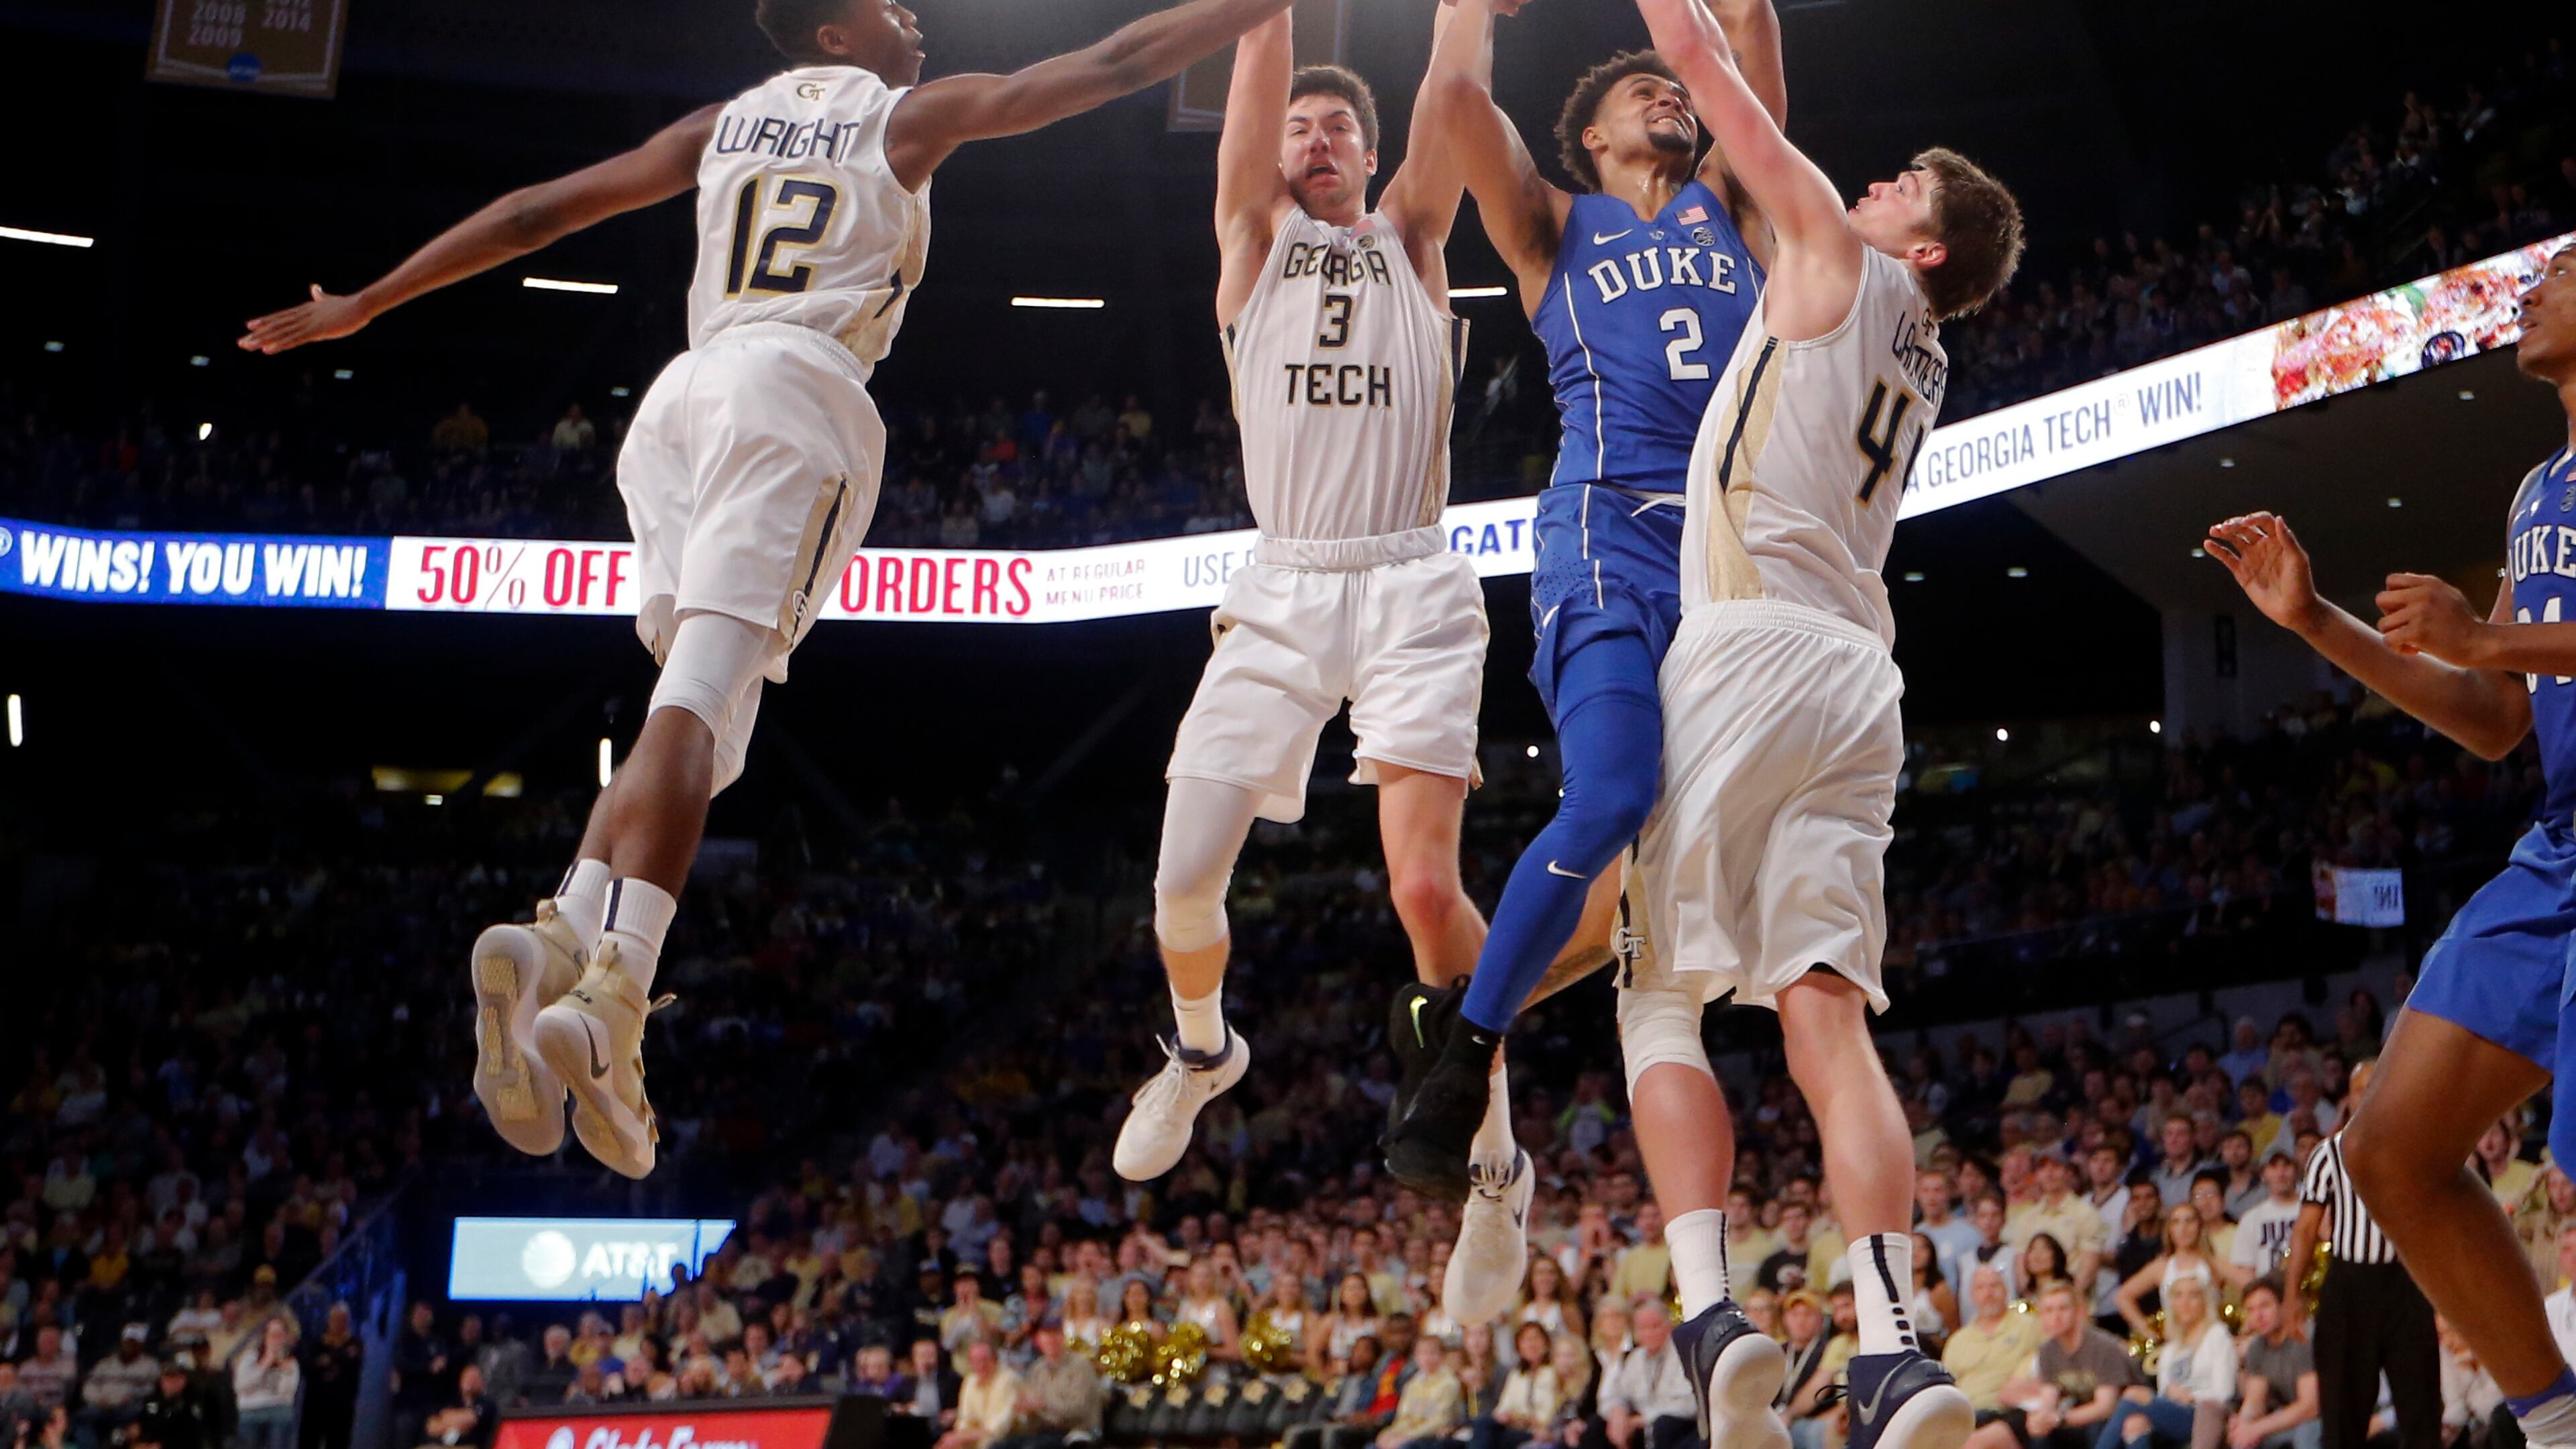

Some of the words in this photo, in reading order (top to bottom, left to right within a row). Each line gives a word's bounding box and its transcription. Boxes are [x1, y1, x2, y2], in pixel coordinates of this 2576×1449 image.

[716, 116, 860, 163] WRIGHT
[724, 172, 843, 300] 12
[1587, 247, 1736, 304] DUKE
[1319, 294, 1354, 349] 3
[1658, 307, 1710, 381] 2
[1284, 364, 1392, 407] TECH
[1927, 424, 2035, 488] GEORGIA
[2137, 371, 2203, 428] WIN!
[20, 530, 156, 594] WINS!
[165, 542, 256, 596] YOU
[264, 543, 368, 598] WIN!
[417, 545, 525, 608] 50%
[543, 547, 633, 607] OFF
[839, 555, 1032, 616] ORDERS
[1046, 567, 1066, 582] AT
[1073, 559, 1145, 581] REGULAR
[1183, 551, 1235, 588] USE
[2509, 525, 2576, 594] UKE
[1046, 588, 1095, 606] MENU
[1099, 582, 1144, 602] PRICE
[582, 1242, 678, 1278] AT&T
